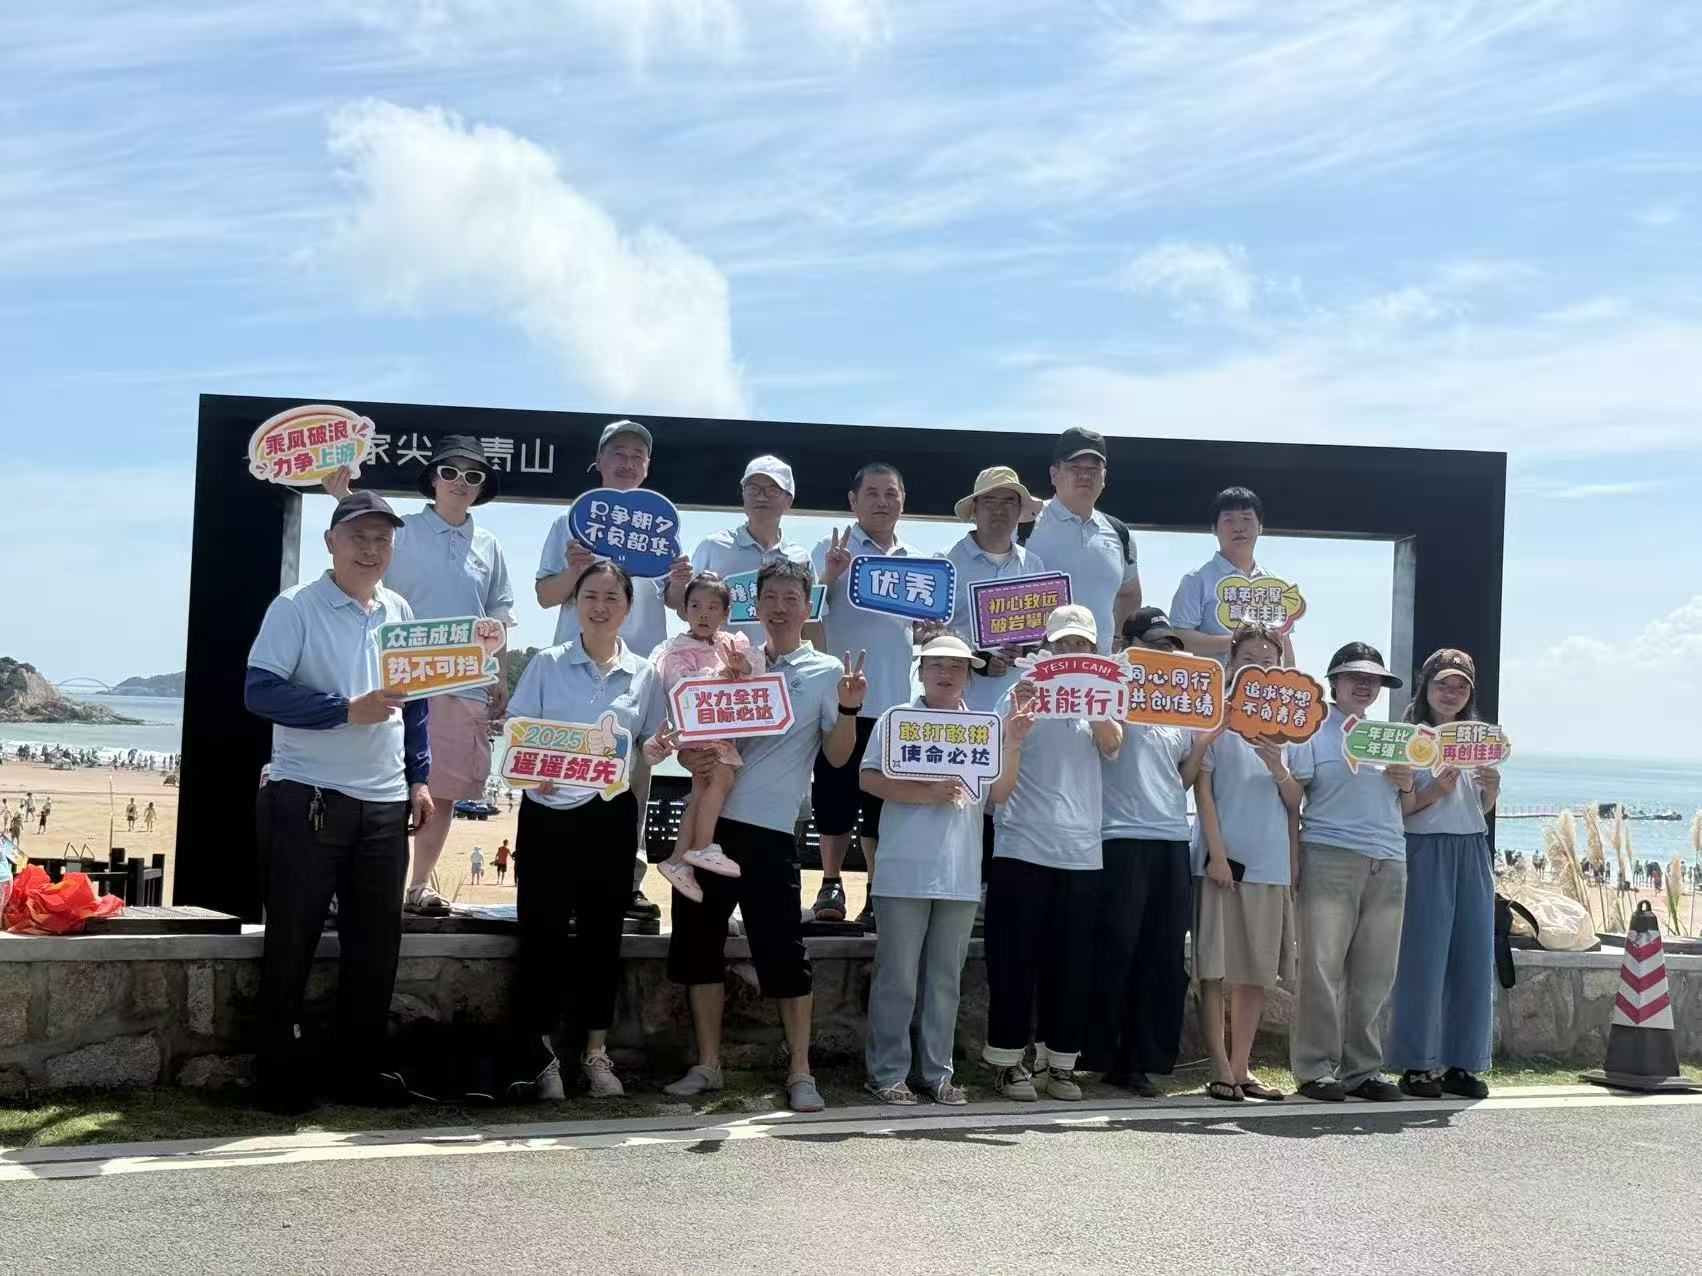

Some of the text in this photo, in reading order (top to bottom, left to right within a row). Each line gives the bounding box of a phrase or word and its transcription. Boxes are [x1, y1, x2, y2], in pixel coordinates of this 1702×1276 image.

[265, 420, 349, 456] 乘风破浪
[273, 440, 356, 478] 力争上游
[590, 500, 674, 534] 只争朝夕
[584, 521, 670, 557] 不负韶华
[869, 569, 936, 607] 优秀
[1223, 586, 1282, 602] 精英齐聚
[988, 590, 1059, 615] 初心致远
[1229, 604, 1287, 621] 赢在未来
[386, 622, 470, 648] 众志成城
[387, 655, 480, 686] 势不可挡
[1041, 660, 1112, 676] YES! I CAN!
[1131, 664, 1211, 691] 同心同行
[694, 687, 770, 708] 火力全开
[1130, 688, 1213, 716] 共创佳绩
[1244, 681, 1311, 707] 追求梦想
[697, 704, 774, 724] 目标必达
[1241, 701, 1307, 727] 不负青春
[523, 725, 585, 750] 2025
[899, 721, 989, 745] 敢打敢拼
[1354, 726, 1410, 743] 一年更比
[1441, 725, 1502, 743] 一鼓作气
[900, 744, 990, 767] 使命必达
[1352, 741, 1396, 757] 一年强
[1443, 744, 1503, 761] 再创佳绩
[509, 750, 618, 785] 遥遥领先
